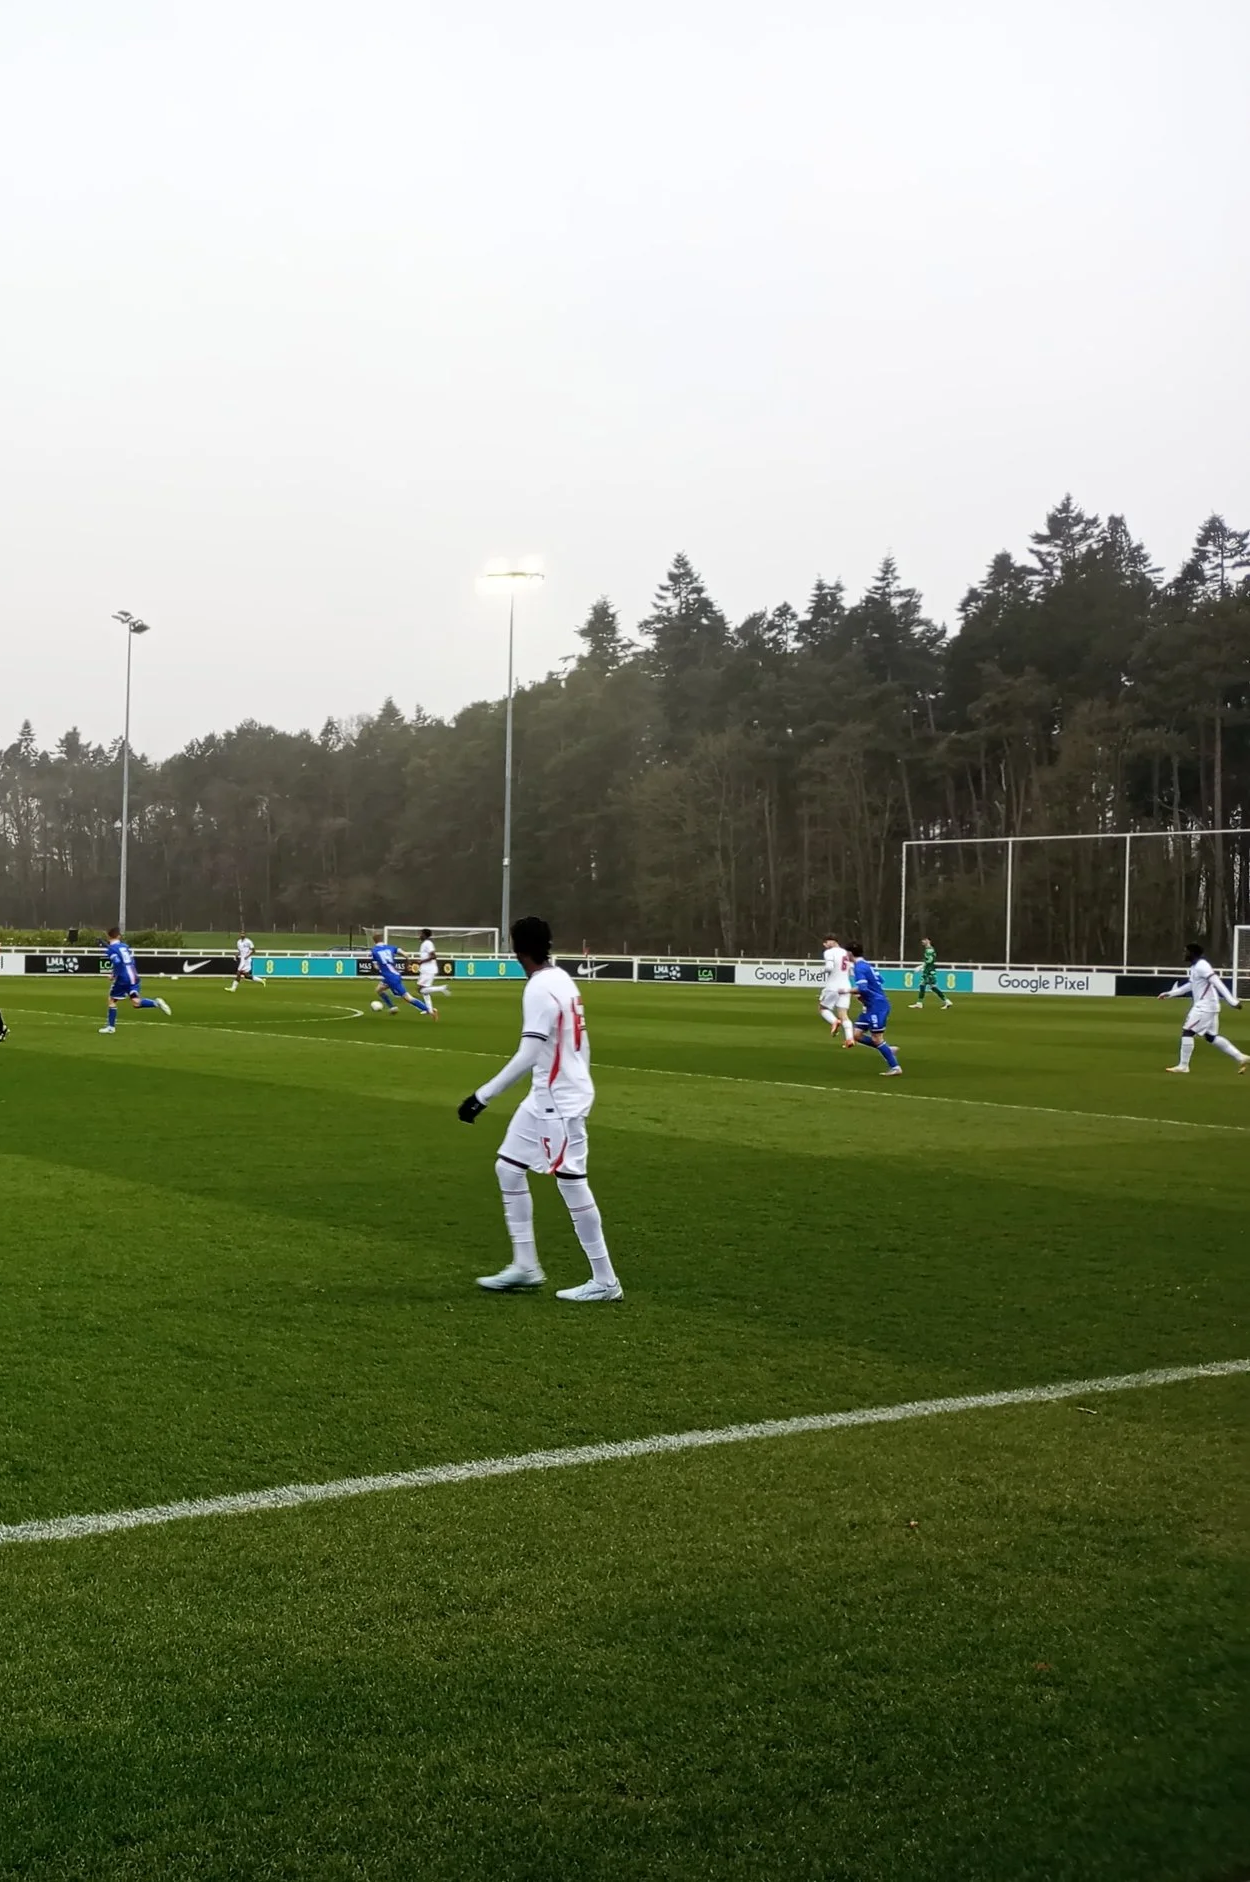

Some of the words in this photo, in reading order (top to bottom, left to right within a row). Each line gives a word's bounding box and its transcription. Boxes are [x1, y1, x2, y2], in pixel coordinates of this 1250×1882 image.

[46, 957, 65, 966] LMA
[697, 969, 714, 978] LCA
[754, 967, 796, 984] Google
[998, 973, 1050, 993] Google
[1054, 975, 1090, 991] Pixel
